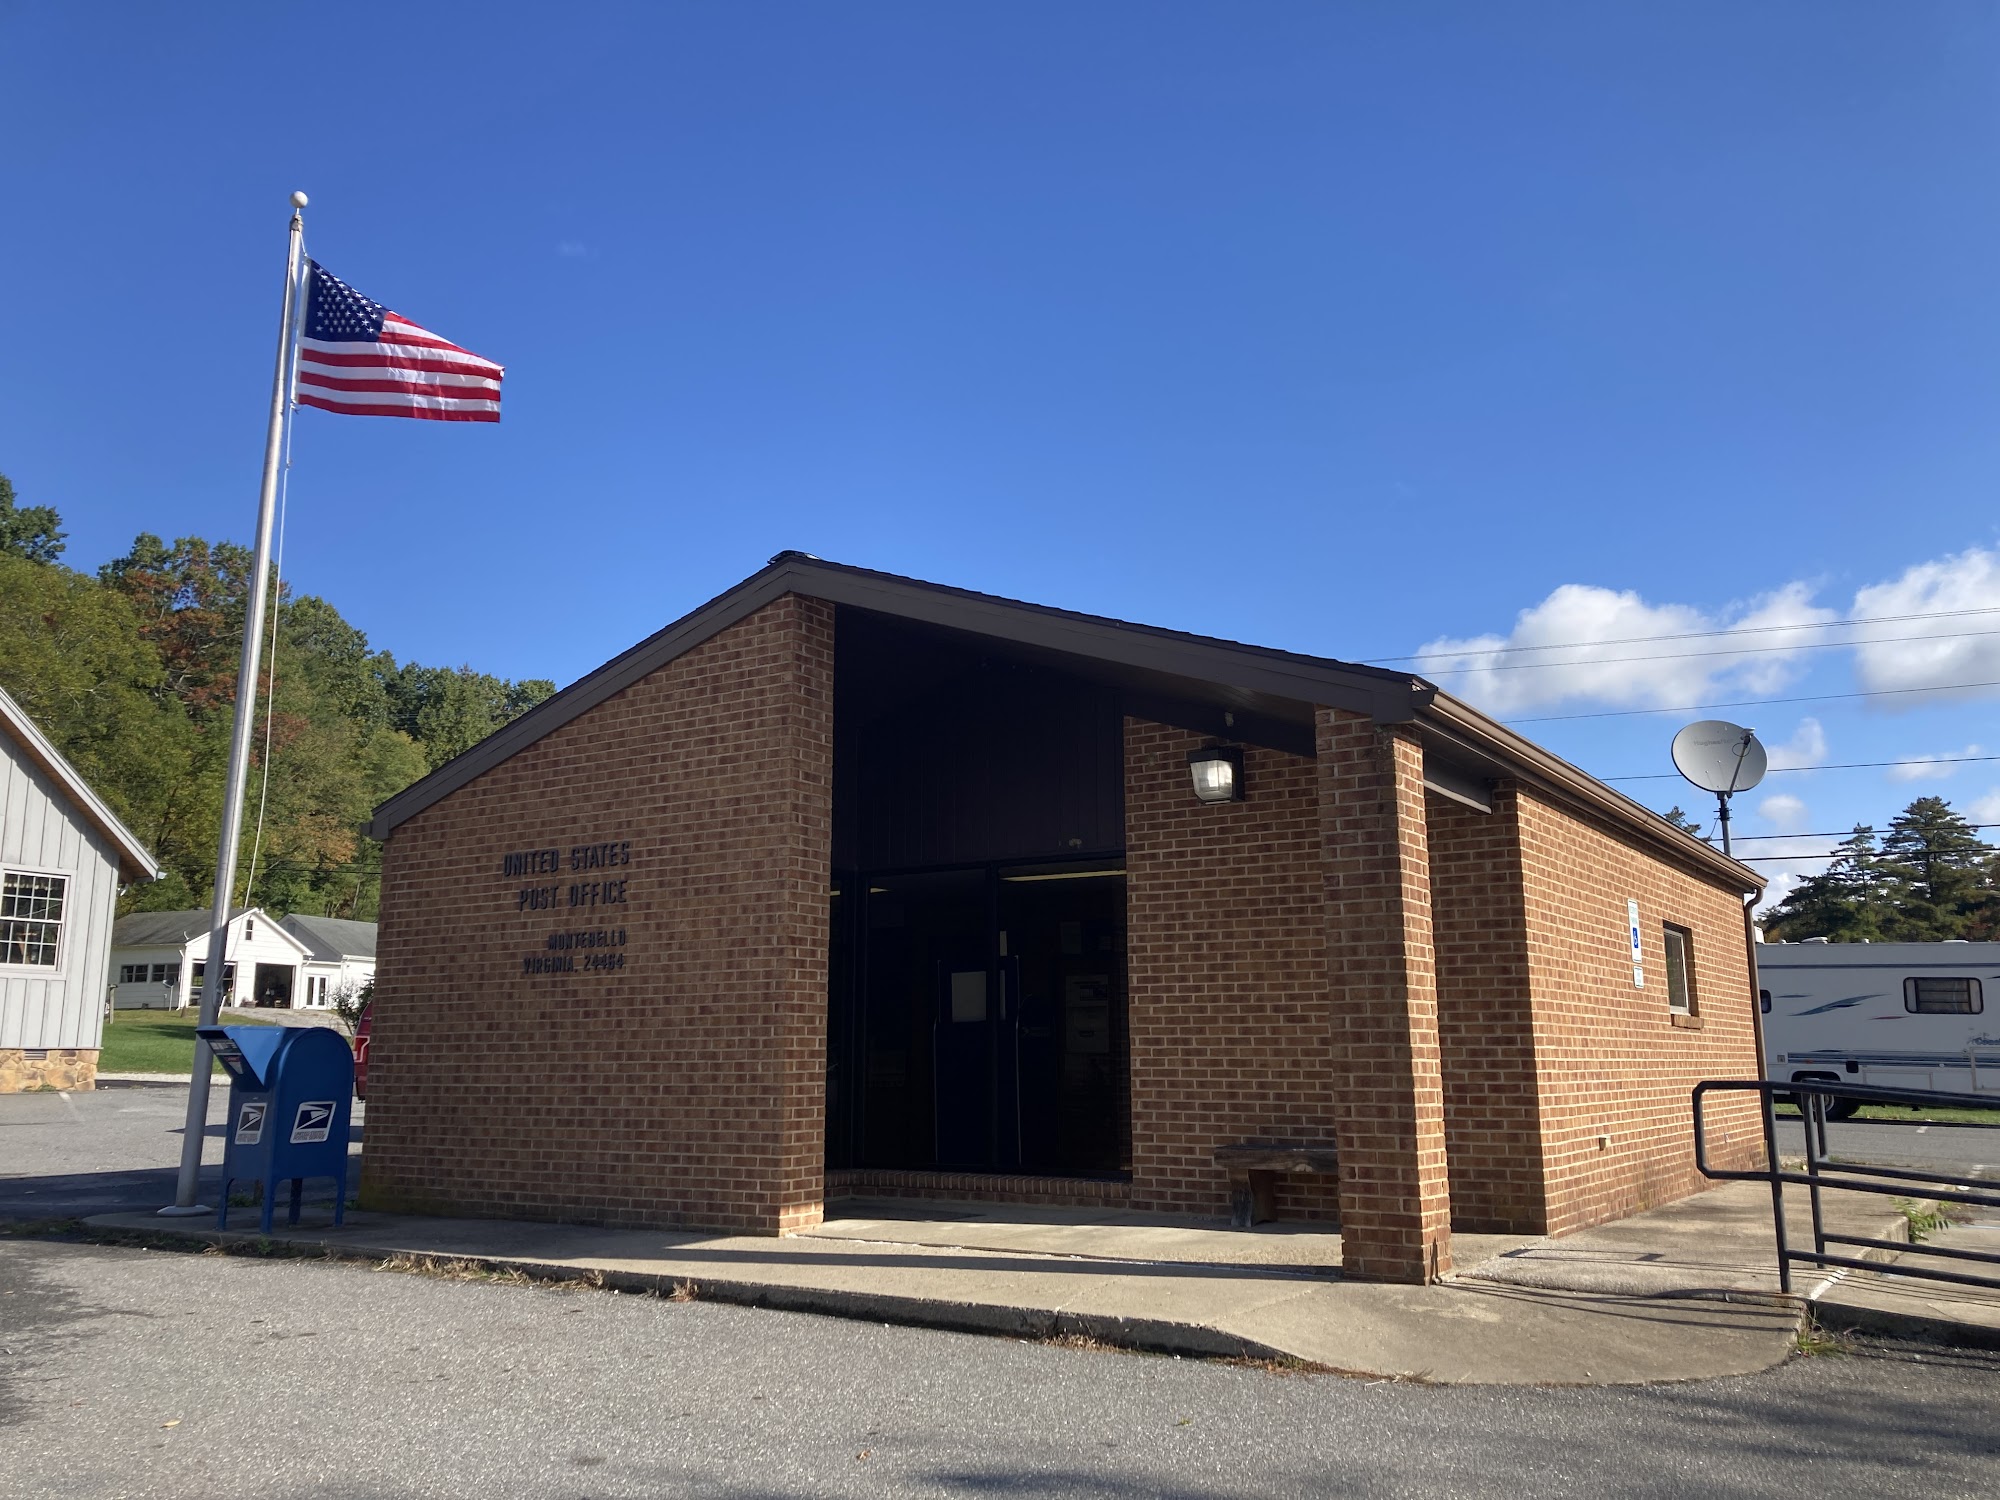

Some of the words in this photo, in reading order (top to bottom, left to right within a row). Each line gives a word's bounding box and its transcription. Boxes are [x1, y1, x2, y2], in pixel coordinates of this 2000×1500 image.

[504, 850, 559, 877] UNITED
[571, 841, 630, 870] STATES
[519, 886, 558, 911] POST
[569, 880, 628, 907] OFFICE
[548, 929, 626, 950] MONTEBELLO
[583, 953, 624, 972] 24464
